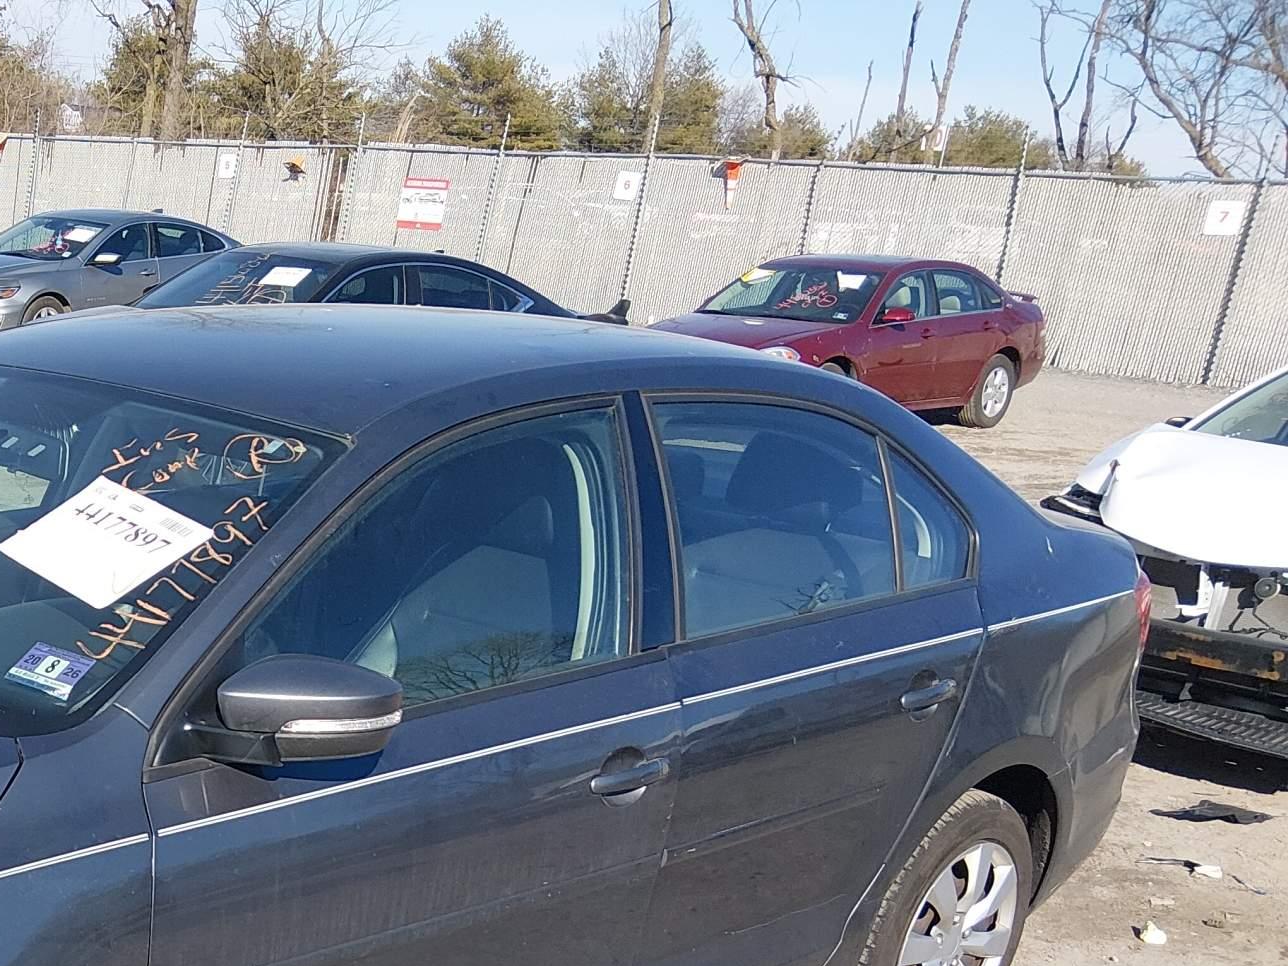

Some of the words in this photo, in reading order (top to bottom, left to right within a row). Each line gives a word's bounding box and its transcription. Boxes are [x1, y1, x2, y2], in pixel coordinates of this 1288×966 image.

[74, 503, 172, 554] 44177897
[75, 494, 271, 660] 44177897
[23, 654, 42, 666] 20
[44, 659, 61, 674] 8
[63, 667, 82, 679] 26
